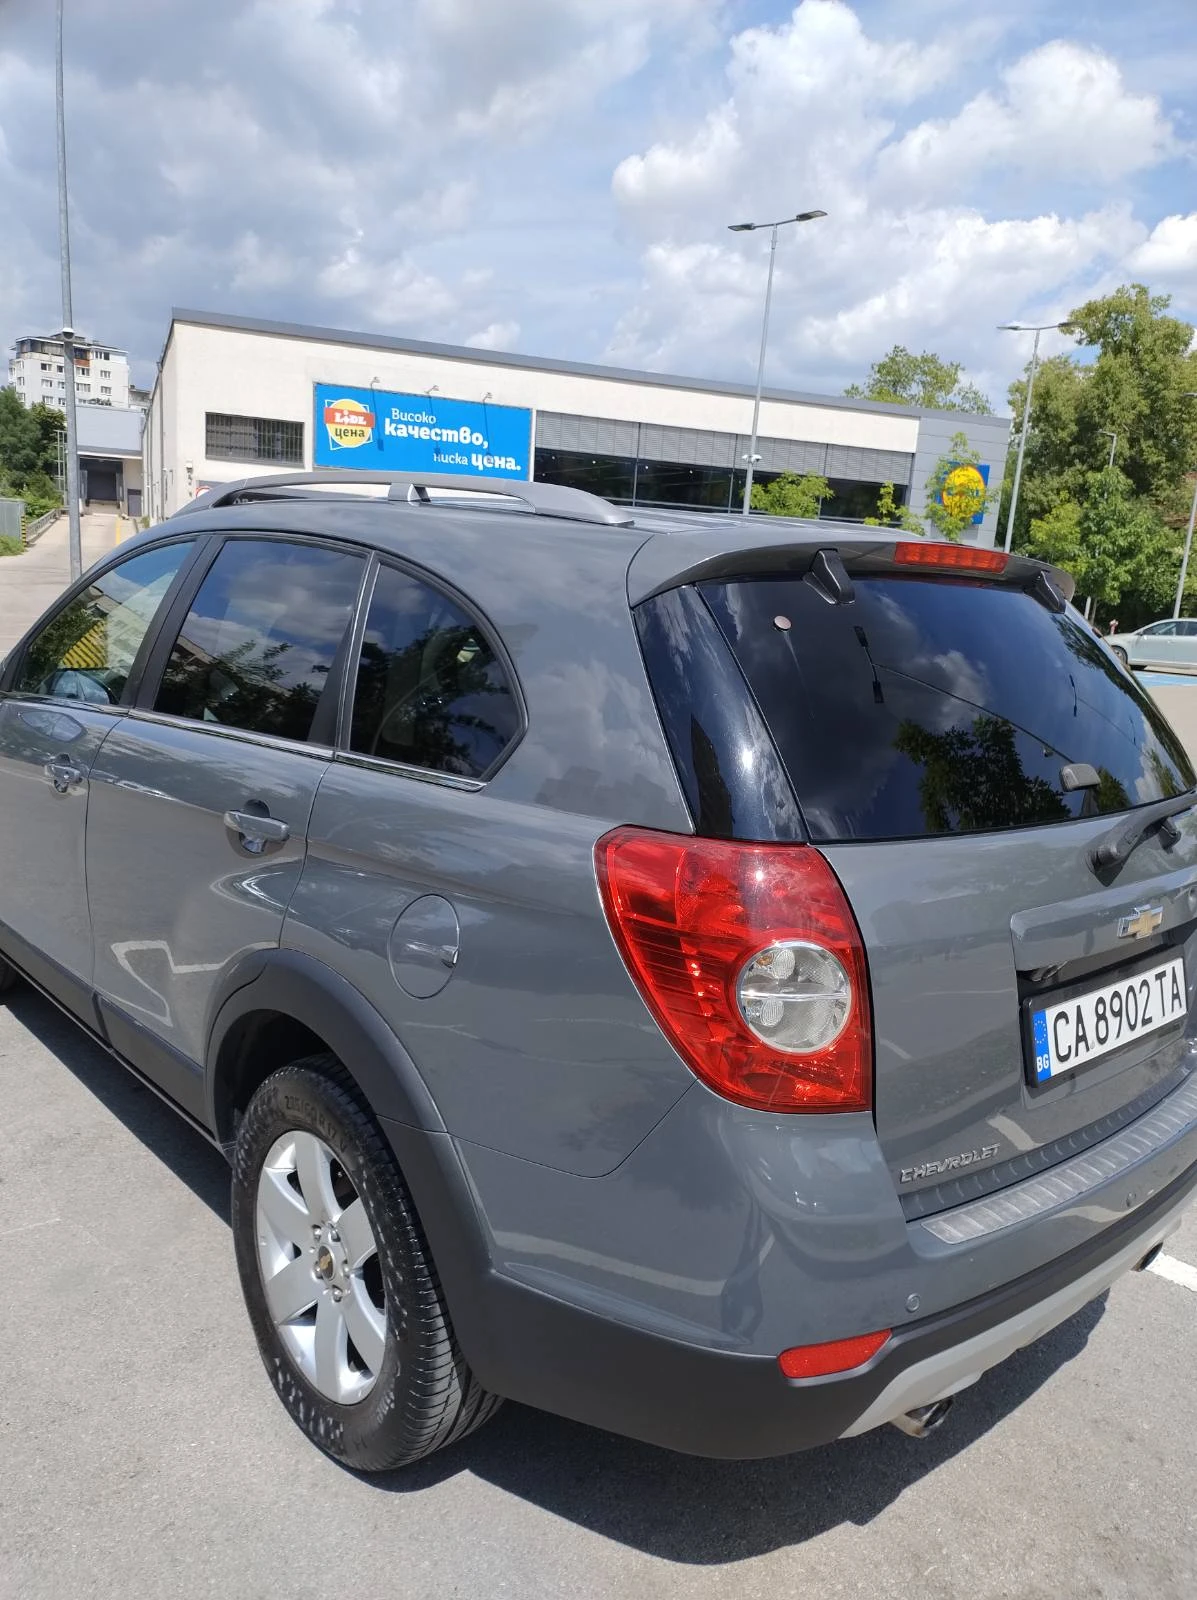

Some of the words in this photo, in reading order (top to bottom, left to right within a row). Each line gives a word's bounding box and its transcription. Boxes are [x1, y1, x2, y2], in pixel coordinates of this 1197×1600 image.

[391, 407, 437, 425] Високо
[334, 427, 365, 440] цена
[384, 417, 489, 449] качество,
[433, 452, 469, 466] ниска
[471, 452, 521, 471] цена.
[1053, 1004, 1090, 1063] CA
[1095, 979, 1153, 1045] 8902
[1155, 966, 1182, 1017] TA
[1036, 1053, 1050, 1073] BG
[900, 1142, 1001, 1184] CHEVROLET
